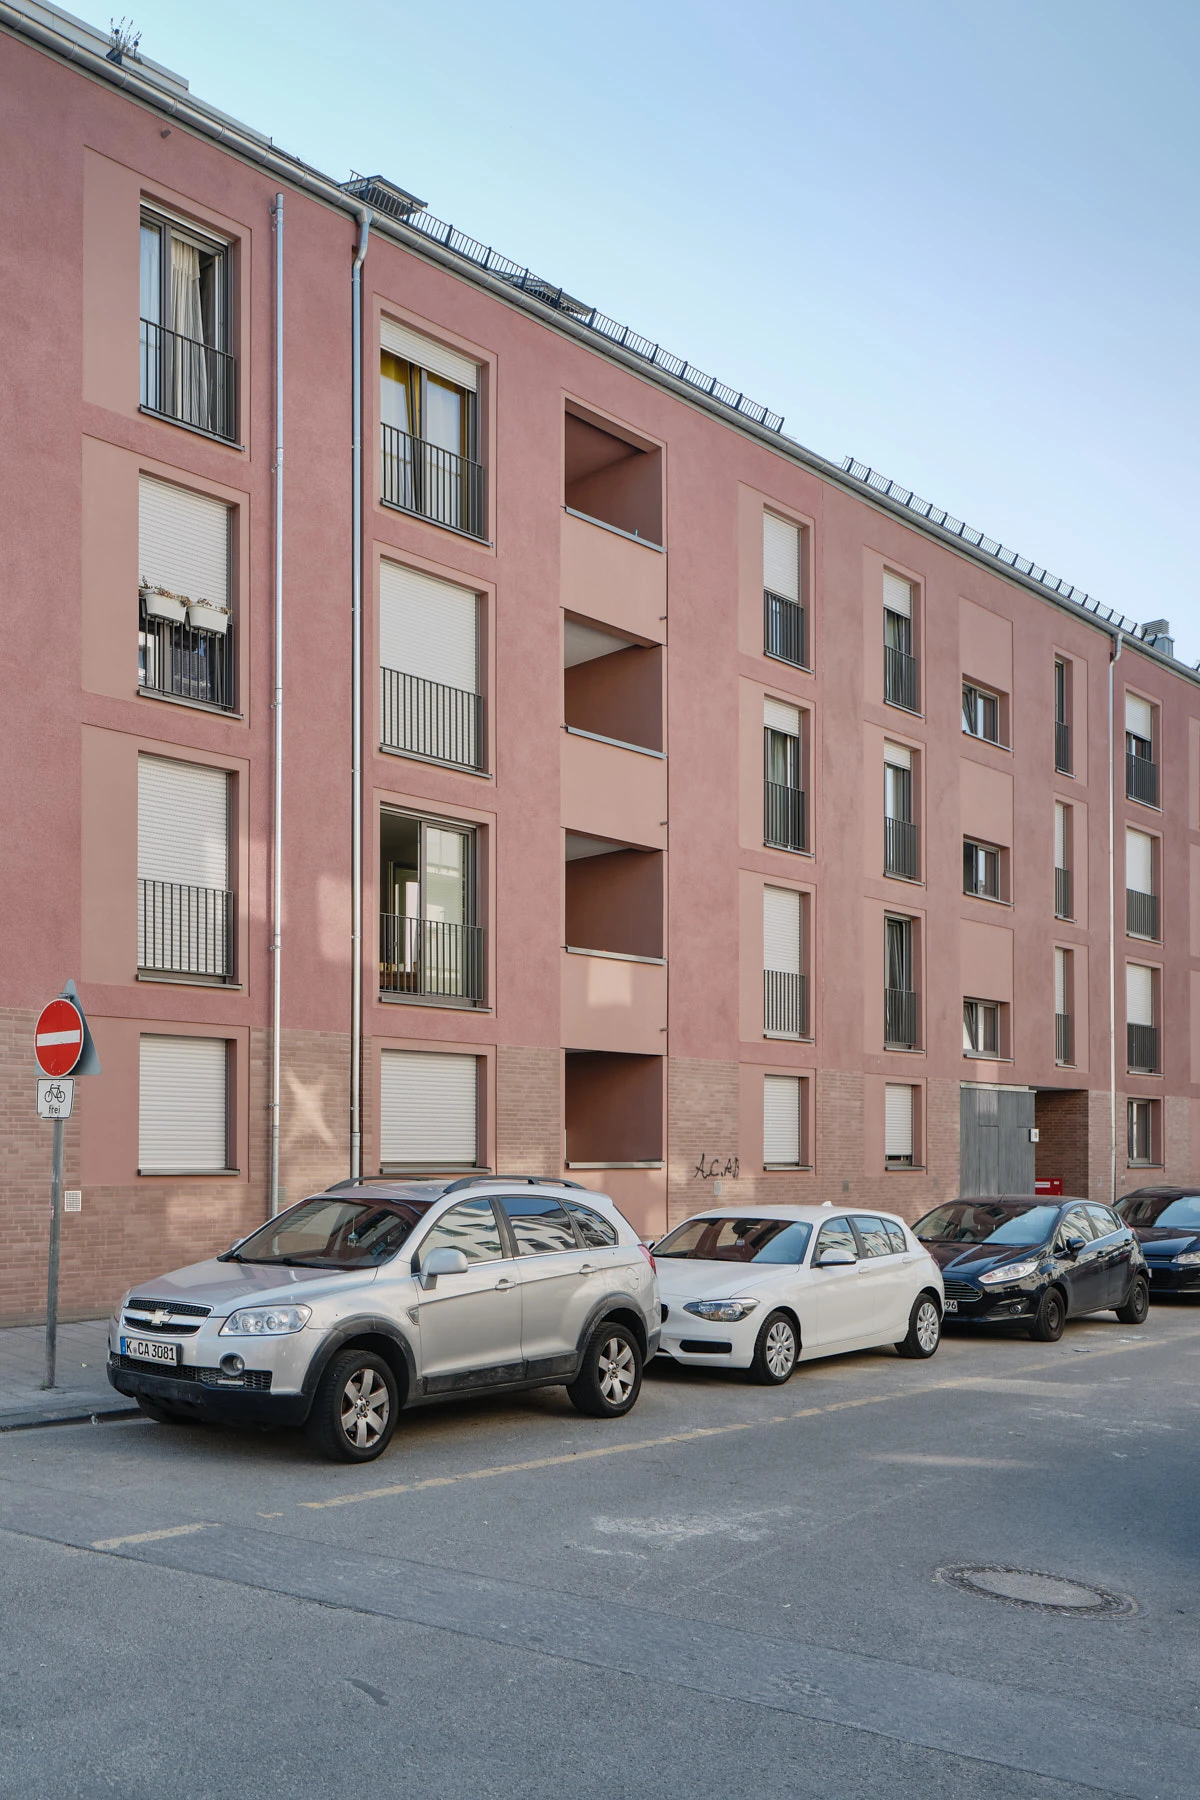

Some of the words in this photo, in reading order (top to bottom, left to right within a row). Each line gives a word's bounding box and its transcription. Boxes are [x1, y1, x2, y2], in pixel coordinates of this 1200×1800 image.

[48, 1104, 61, 1114] frei
[944, 1300, 957, 1310] 96
[126, 1340, 132, 1354] K
[137, 1342, 150, 1357] CA
[151, 1344, 175, 1361] 3081
